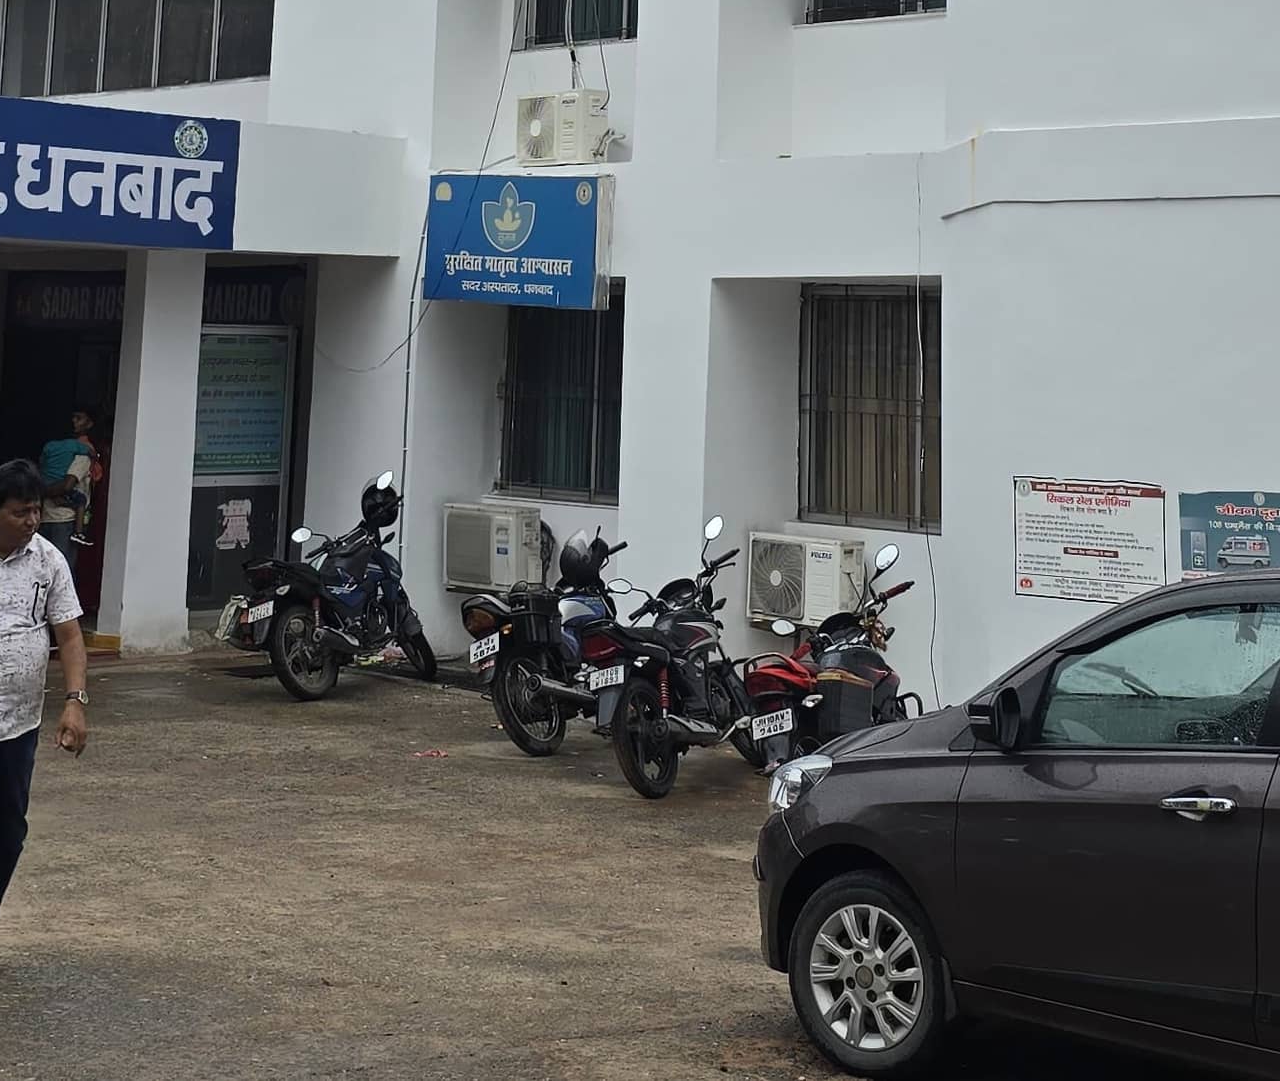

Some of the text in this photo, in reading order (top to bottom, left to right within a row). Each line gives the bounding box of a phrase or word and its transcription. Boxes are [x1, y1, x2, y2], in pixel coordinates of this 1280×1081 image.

[14, 142, 224, 236] धनबाद
[461, 280, 481, 291] सदर
[41, 286, 90, 320] SADAR
[1215, 502, 1257, 518] जीवन
[810, 551, 833, 560] VOLTAS
